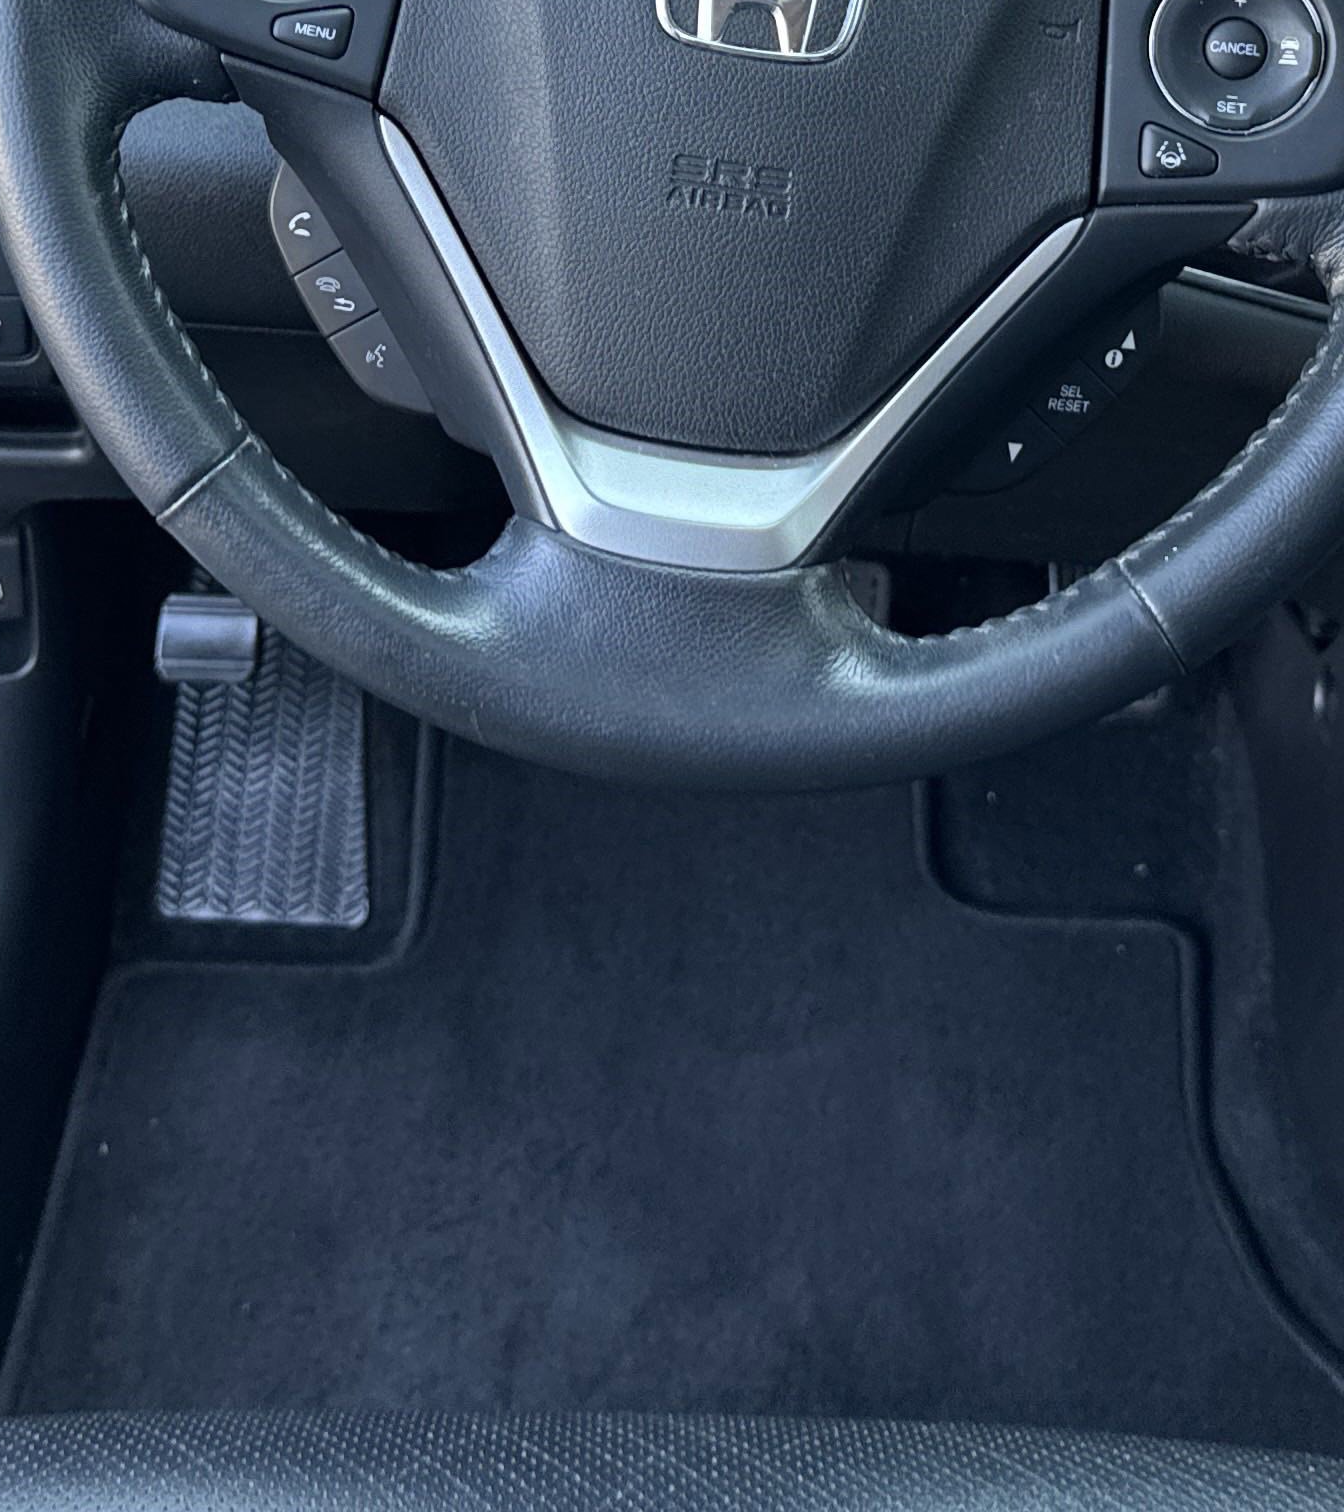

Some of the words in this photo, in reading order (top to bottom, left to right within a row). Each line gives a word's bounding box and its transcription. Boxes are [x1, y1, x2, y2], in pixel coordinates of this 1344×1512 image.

[294, 22, 336, 40] MENU
[1209, 40, 1260, 57] CANCEL
[1216, 101, 1248, 115] SET
[670, 154, 793, 195] SRS
[1060, 384, 1084, 398] SEL
[1047, 397, 1090, 413] RESET
